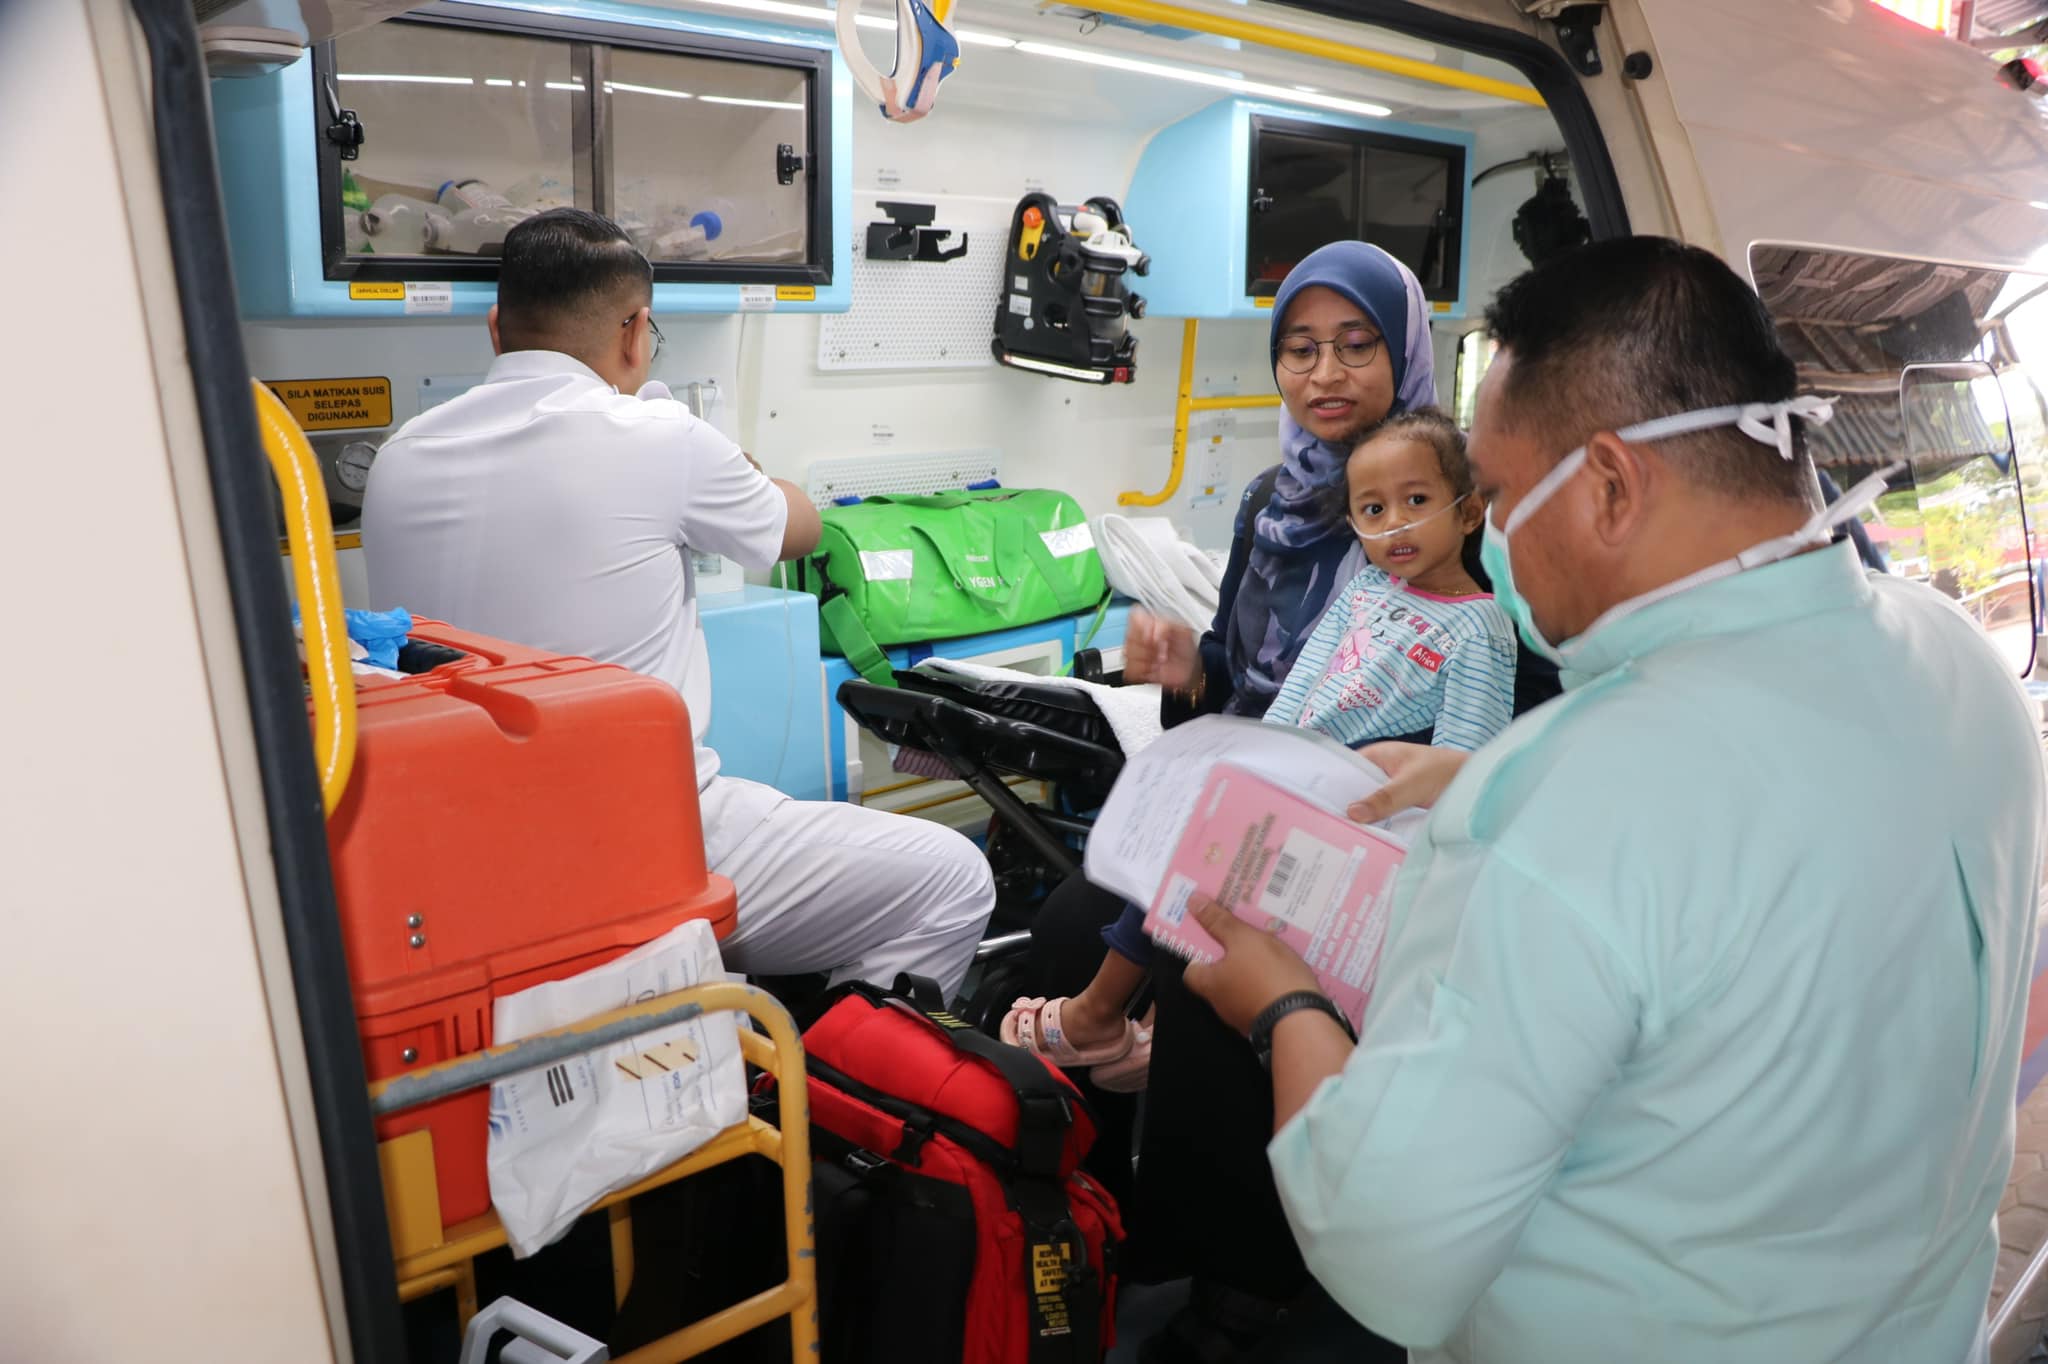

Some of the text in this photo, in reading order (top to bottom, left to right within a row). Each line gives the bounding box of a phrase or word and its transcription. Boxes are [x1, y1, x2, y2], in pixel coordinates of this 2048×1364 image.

[287, 386, 385, 399] SILA MATIKAN SUIS
[314, 399, 361, 410] SELEPAS
[307, 410, 368, 421] DIGUNAKAN
[1412, 646, 1436, 669] Africa
